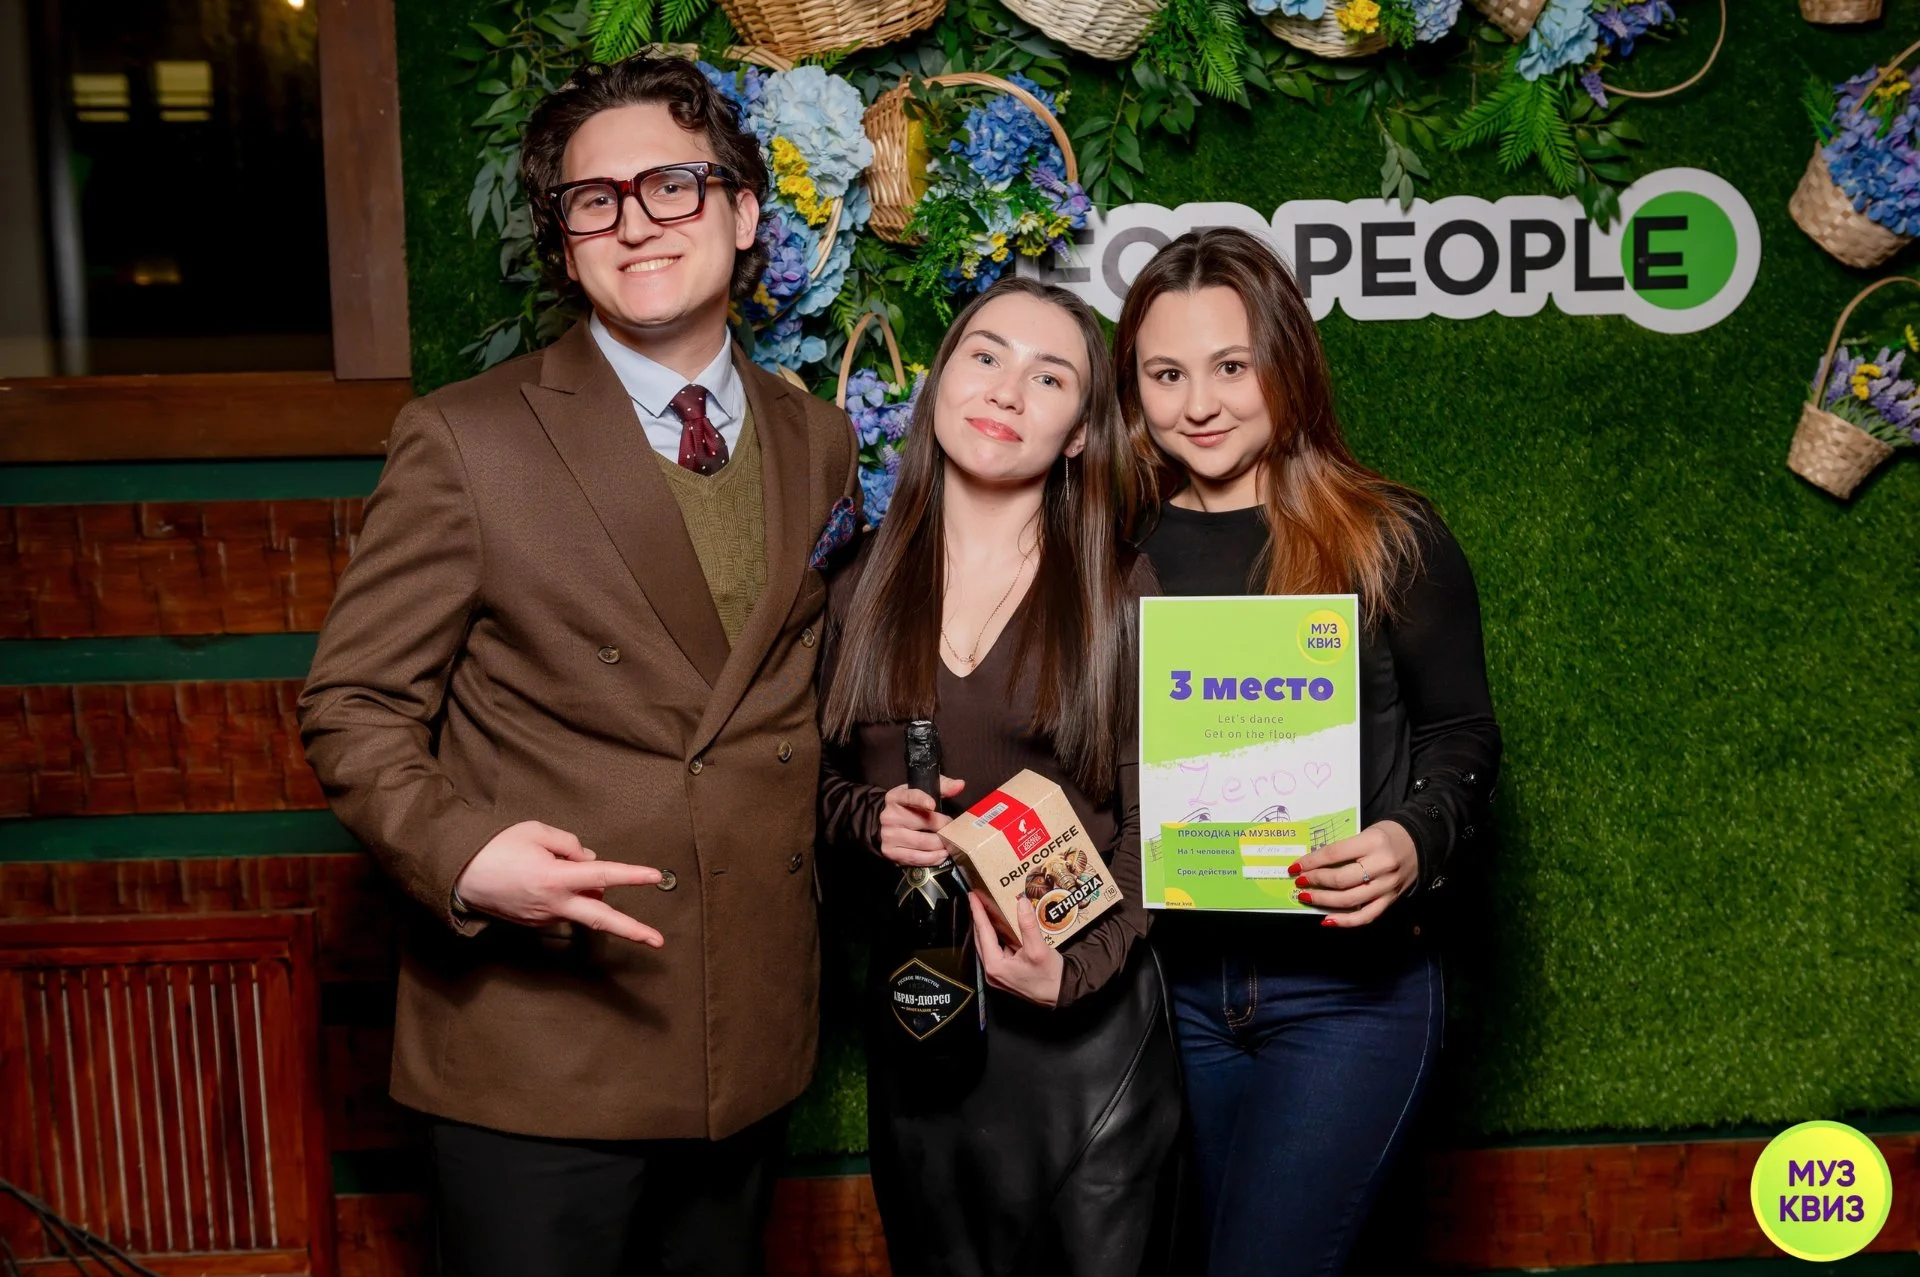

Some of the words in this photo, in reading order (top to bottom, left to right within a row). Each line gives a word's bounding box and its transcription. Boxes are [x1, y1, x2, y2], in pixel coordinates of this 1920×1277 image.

[1293, 215, 1690, 299] PEOPLE
[1311, 623, 1338, 635] МУЗ
[1307, 637, 1342, 649] КВИЗ
[1169, 670, 1193, 701] 3
[1203, 677, 1335, 702] место
[1218, 714, 1246, 724] Let's
[1250, 714, 1285, 724] dance
[1204, 729, 1224, 739] Get
[1228, 731, 1242, 739] on
[1246, 729, 1265, 739] the
[1269, 729, 1297, 740] floor
[1179, 761, 1298, 807] Zero
[1178, 829, 1231, 839] ПРОХОДКА
[1233, 829, 1247, 838] НА
[1249, 829, 1297, 838] МУЗКВИЗ
[999, 861, 1030, 888] DRIP
[1031, 825, 1079, 866] COFFEE
[1177, 868, 1197, 876] Срок
[1198, 868, 1238, 876] действия
[1049, 877, 1103, 920] ETHIOPIA
